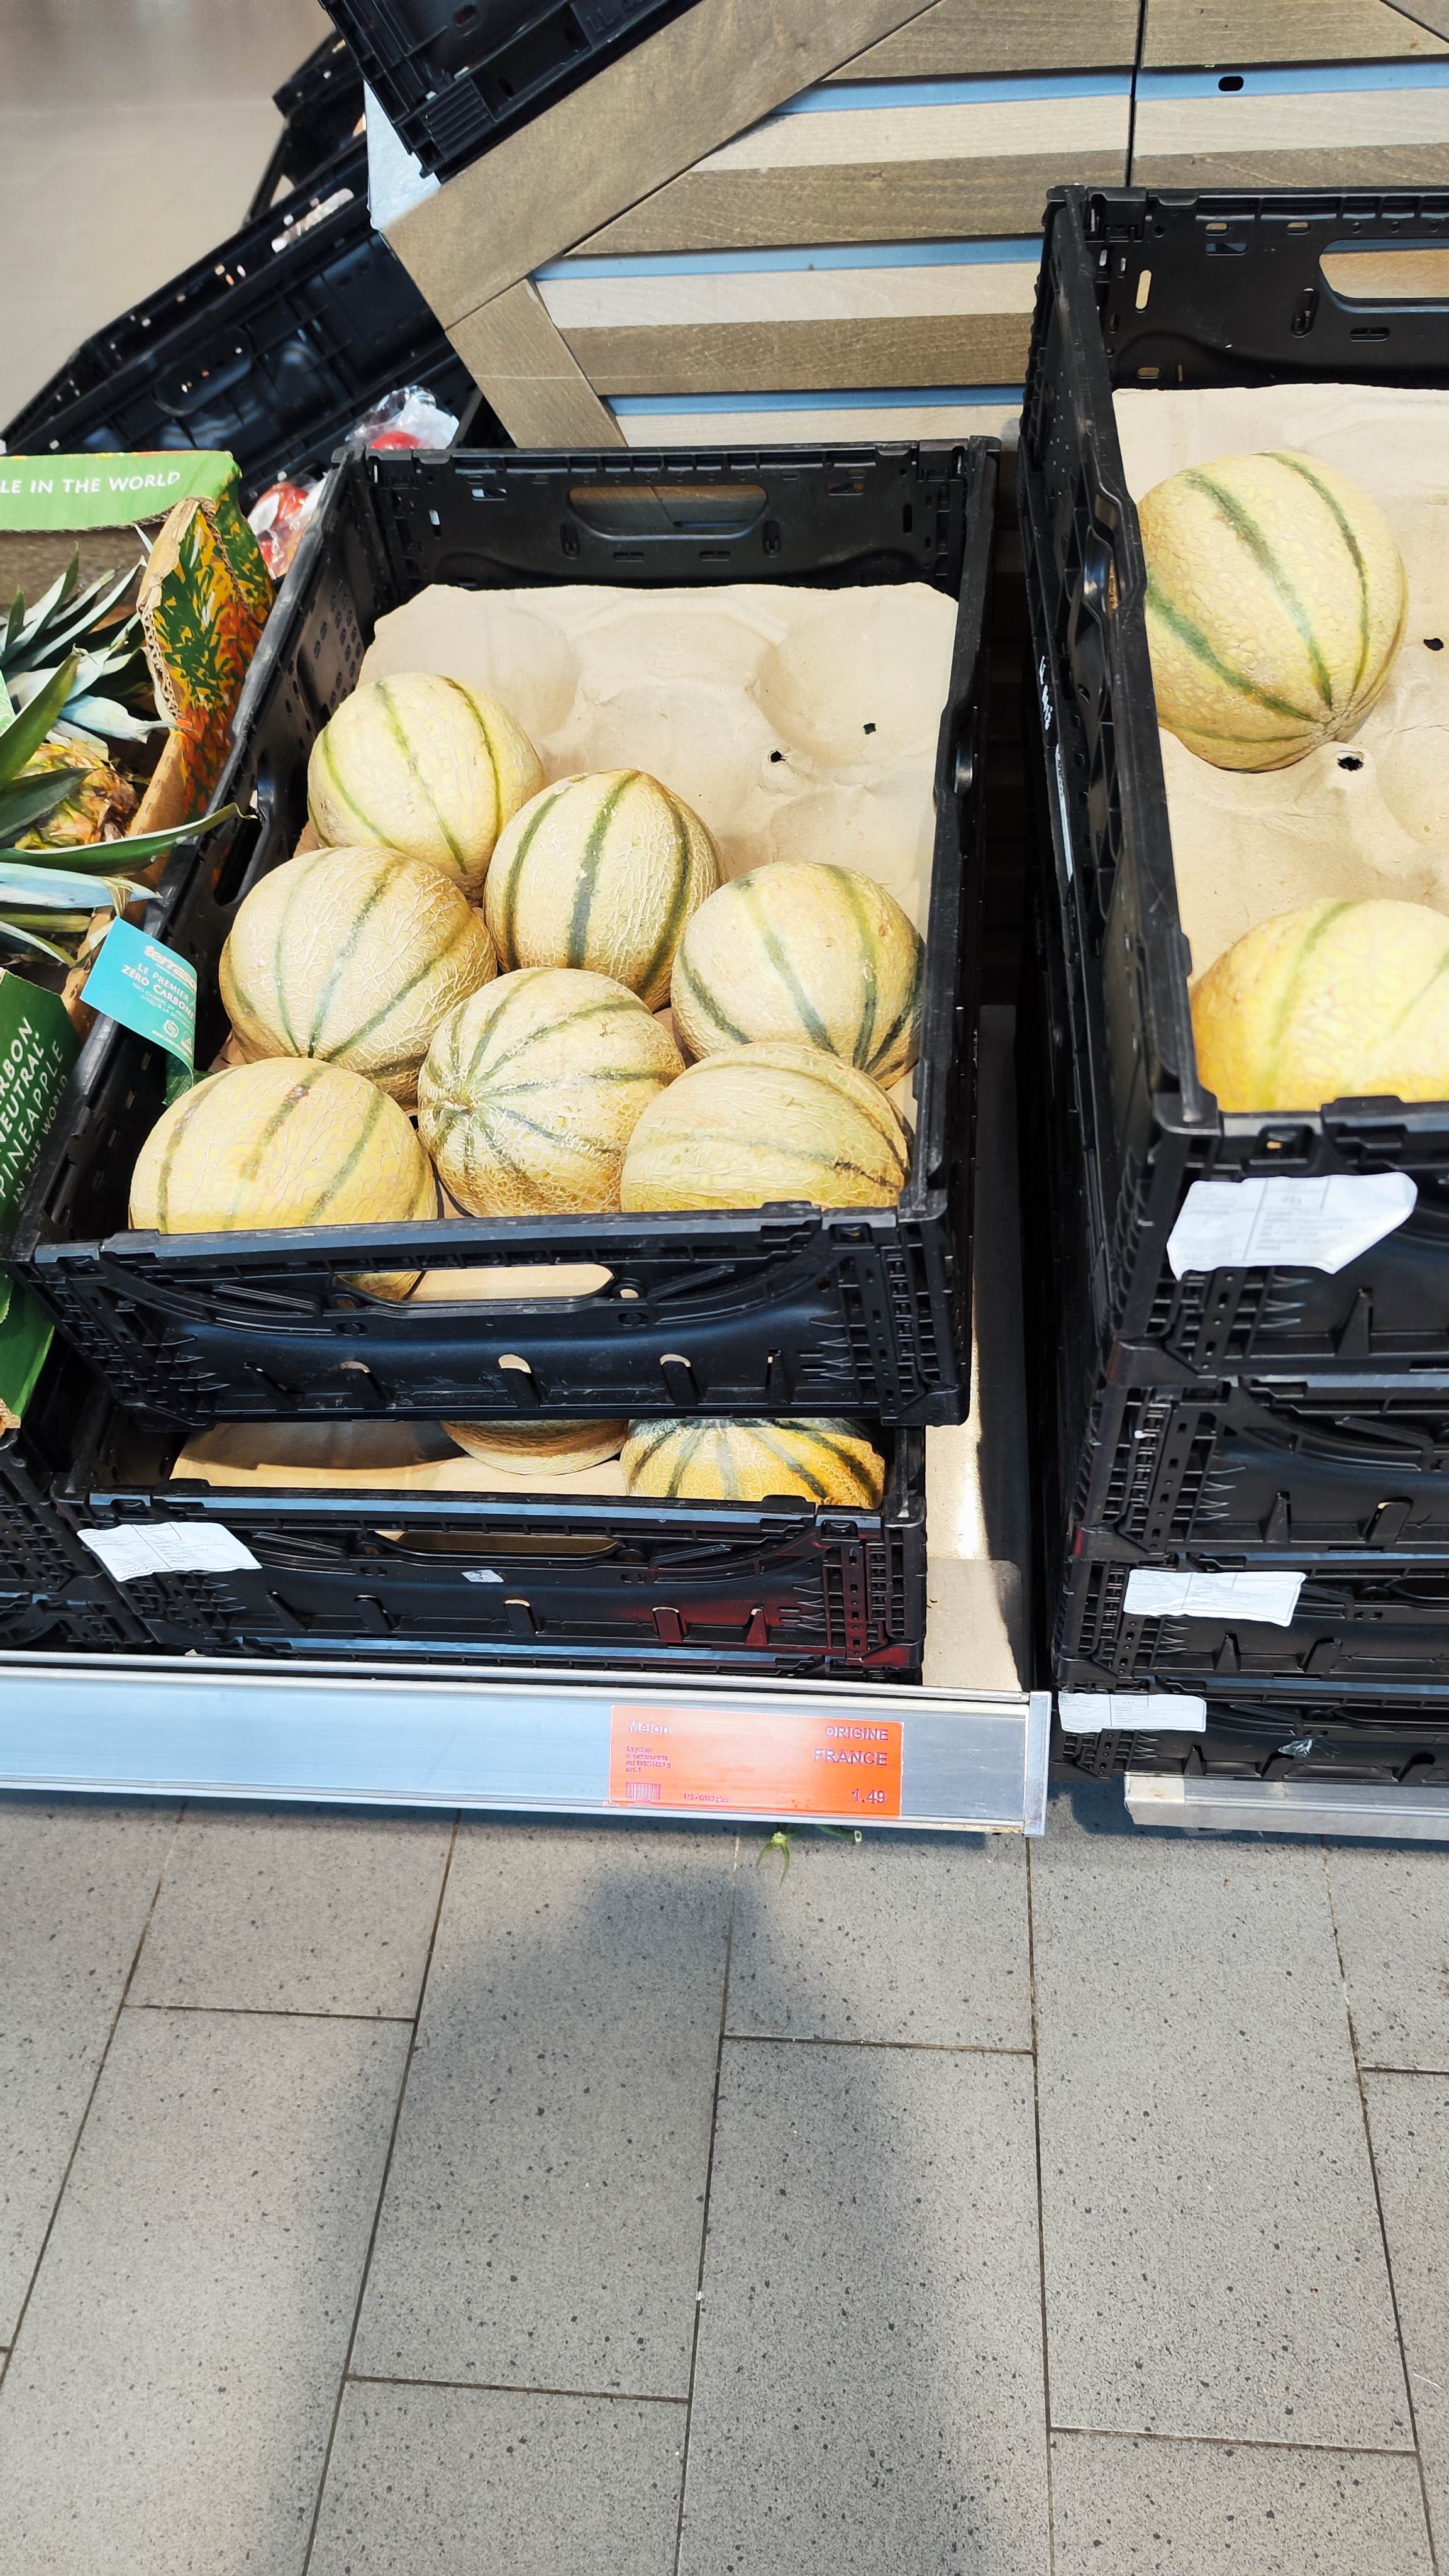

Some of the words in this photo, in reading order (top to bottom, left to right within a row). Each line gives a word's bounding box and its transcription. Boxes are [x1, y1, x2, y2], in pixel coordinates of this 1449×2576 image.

[0, 480, 22, 494] LE
[30, 480, 53, 494] IN
[63, 479, 101, 494] THE
[108, 472, 181, 492] WORLD
[138, 963, 150, 975] LE
[0, 1017, 33, 1097] RBON
[0, 1041, 64, 1198] PINEAPPLE
[628, 1721, 670, 1734] Melon
[825, 1726, 888, 1741] ORIGINE
[813, 1748, 887, 1766] FRANCE
[852, 1788, 886, 1804] 1.49
